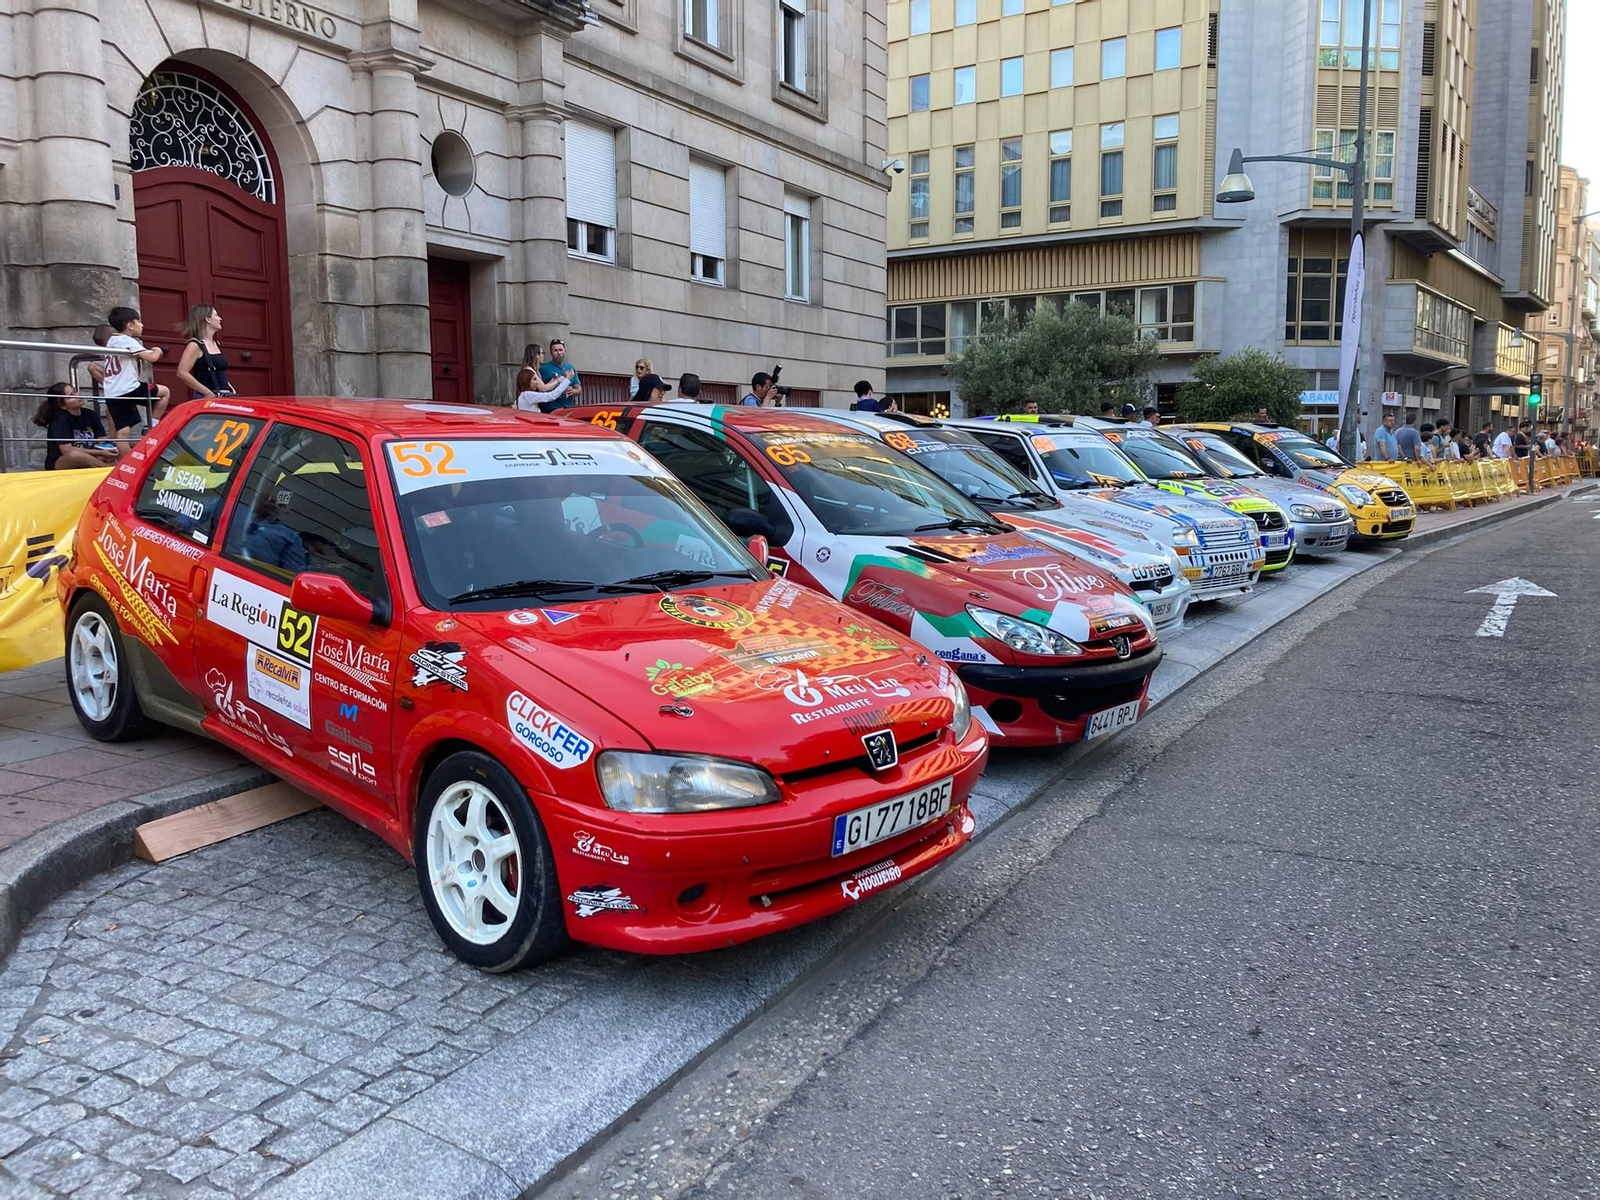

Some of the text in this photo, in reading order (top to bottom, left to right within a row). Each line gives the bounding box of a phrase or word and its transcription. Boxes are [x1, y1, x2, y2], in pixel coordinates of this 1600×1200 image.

[225, 0, 337, 39] IERNO
[590, 411, 622, 432] 65
[206, 420, 250, 467] 52
[766, 444, 811, 466] 65
[884, 432, 918, 450] 68
[392, 442, 466, 477] 52
[175, 470, 207, 494] SEARA
[156, 489, 204, 521] SANMAMED
[107, 512, 127, 541] Talleres
[132, 526, 204, 561] ¿QUIERES FORMARTE?
[98, 521, 177, 618] José María
[90, 574, 111, 602] CENTRO
[110, 597, 120, 611] DE
[211, 583, 277, 630] La Región
[279, 607, 313, 658] 52
[321, 630, 345, 644] Talleres
[263, 658, 292, 681] Recalvi
[318, 638, 390, 673] José María
[265, 689, 293, 710] recoletas
[293, 700, 309, 718] salud
[314, 672, 387, 712] CENTRO DE FORMACIÓN
[508, 693, 590, 761] CLICKFER
[790, 698, 873, 725] RESTAURANTE
[1091, 704, 1137, 735] 6441 BPJ
[515, 722, 564, 763] GORGOSO
[572, 848, 606, 862] RESTAURANTE
[836, 839, 843, 849] E
